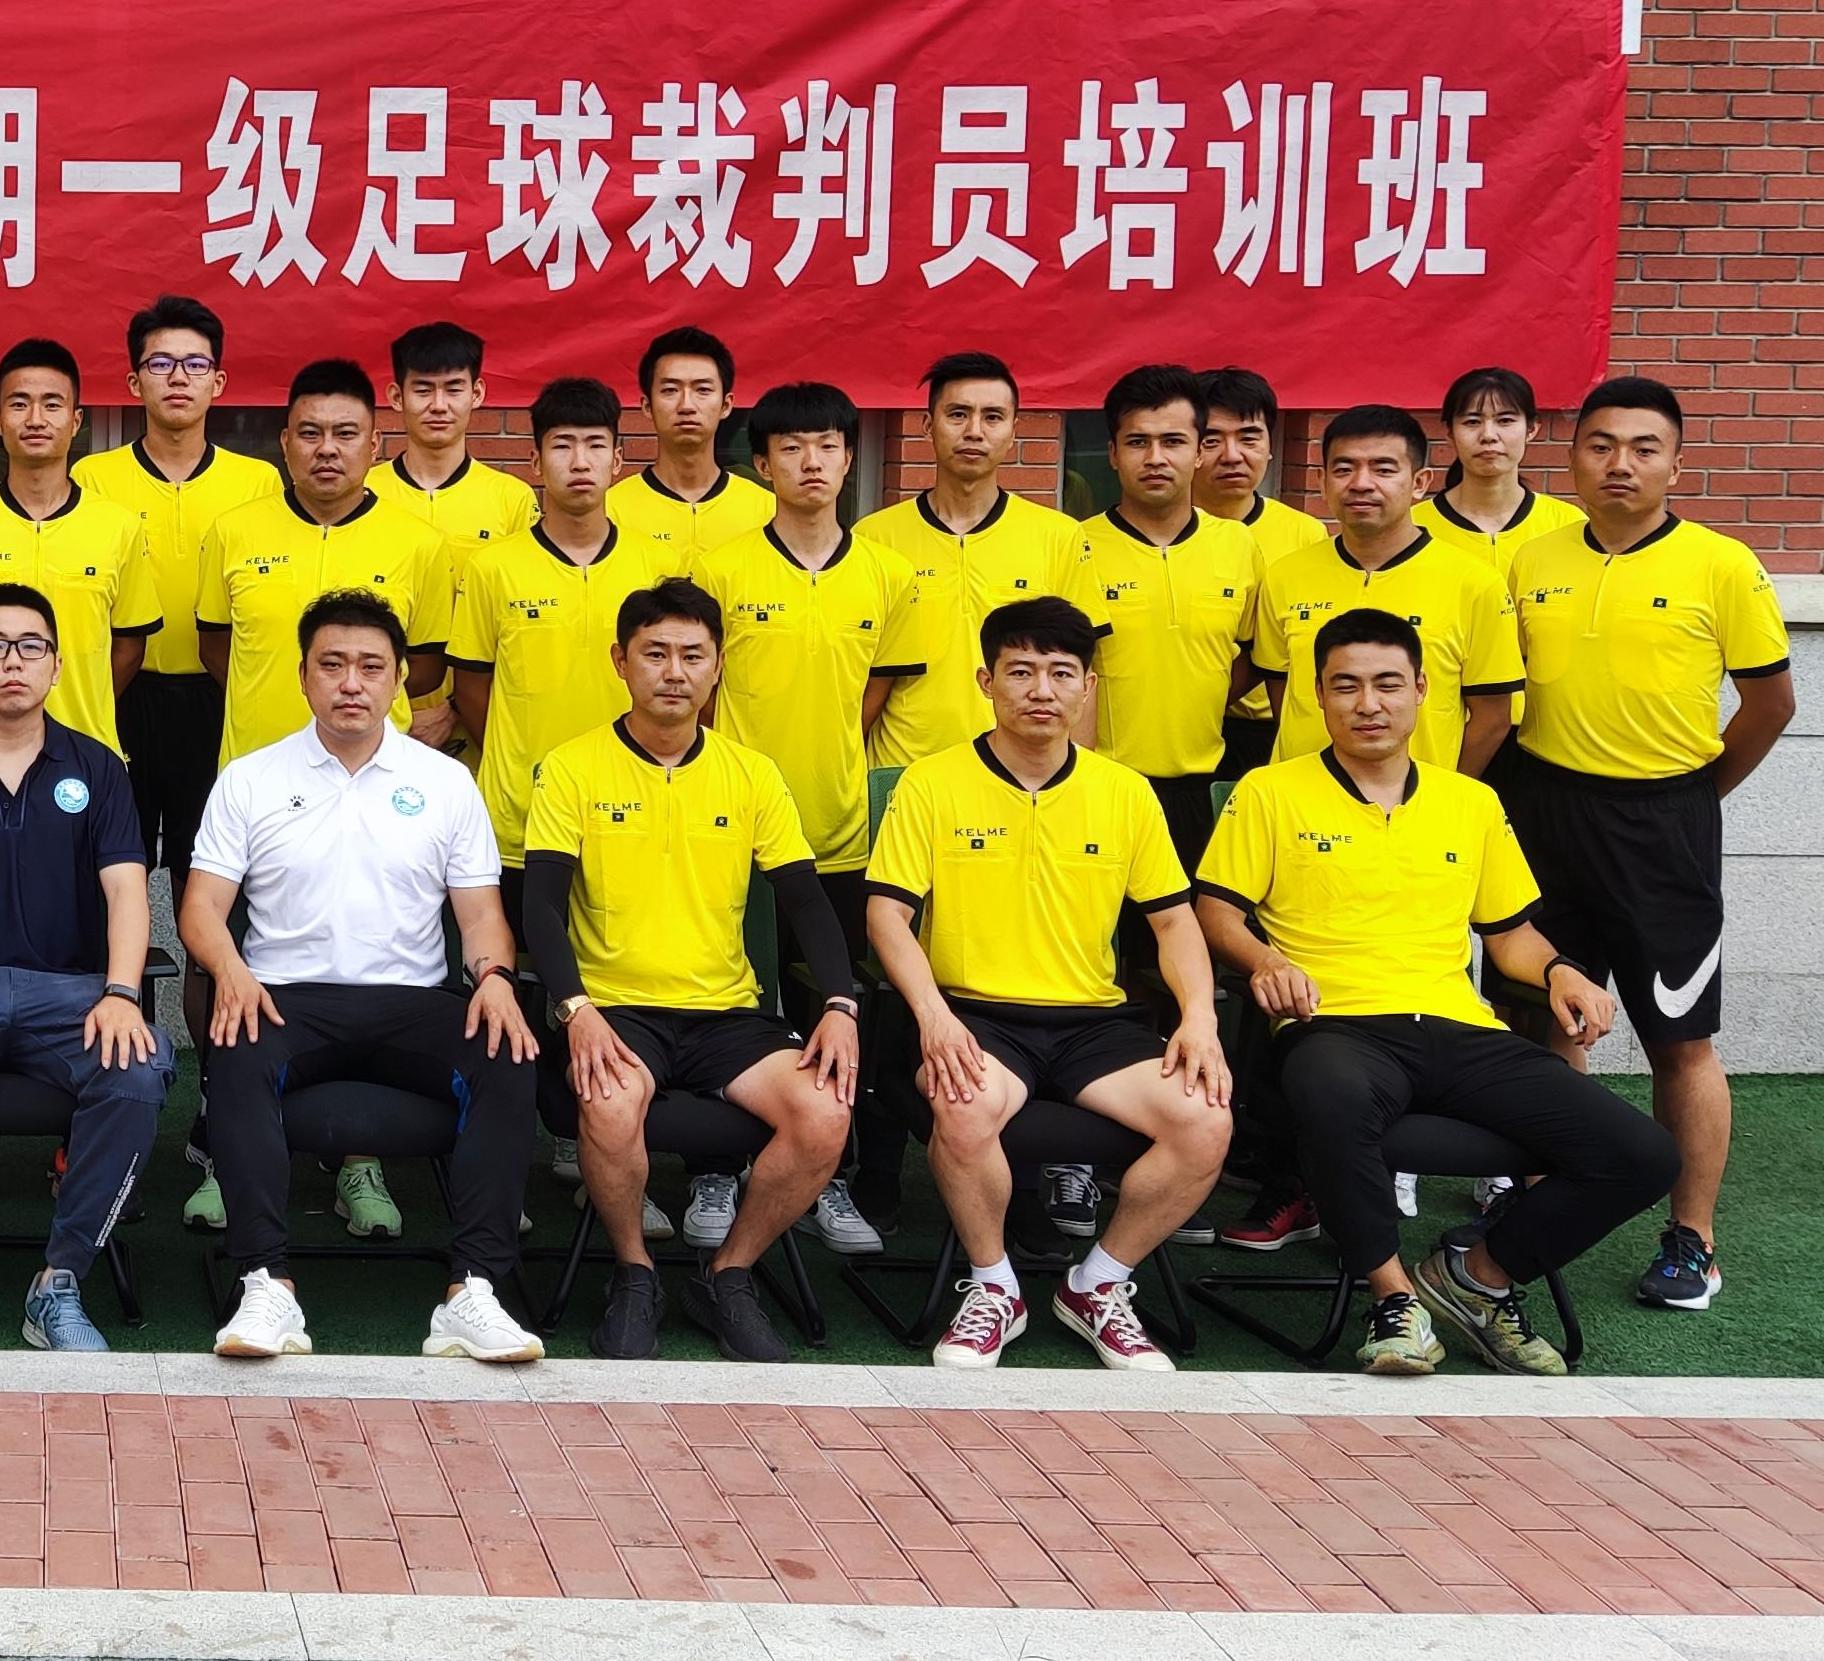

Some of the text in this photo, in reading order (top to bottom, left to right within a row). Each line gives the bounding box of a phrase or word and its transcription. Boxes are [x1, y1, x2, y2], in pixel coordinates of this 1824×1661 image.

[245, 556, 290, 566] KELME
[509, 599, 558, 609] KELME
[736, 603, 785, 612] KELME
[1289, 602, 1334, 612] KELME
[594, 802, 642, 812] KELME
[955, 827, 1007, 837] KELME
[1298, 832, 1354, 844] KELME
